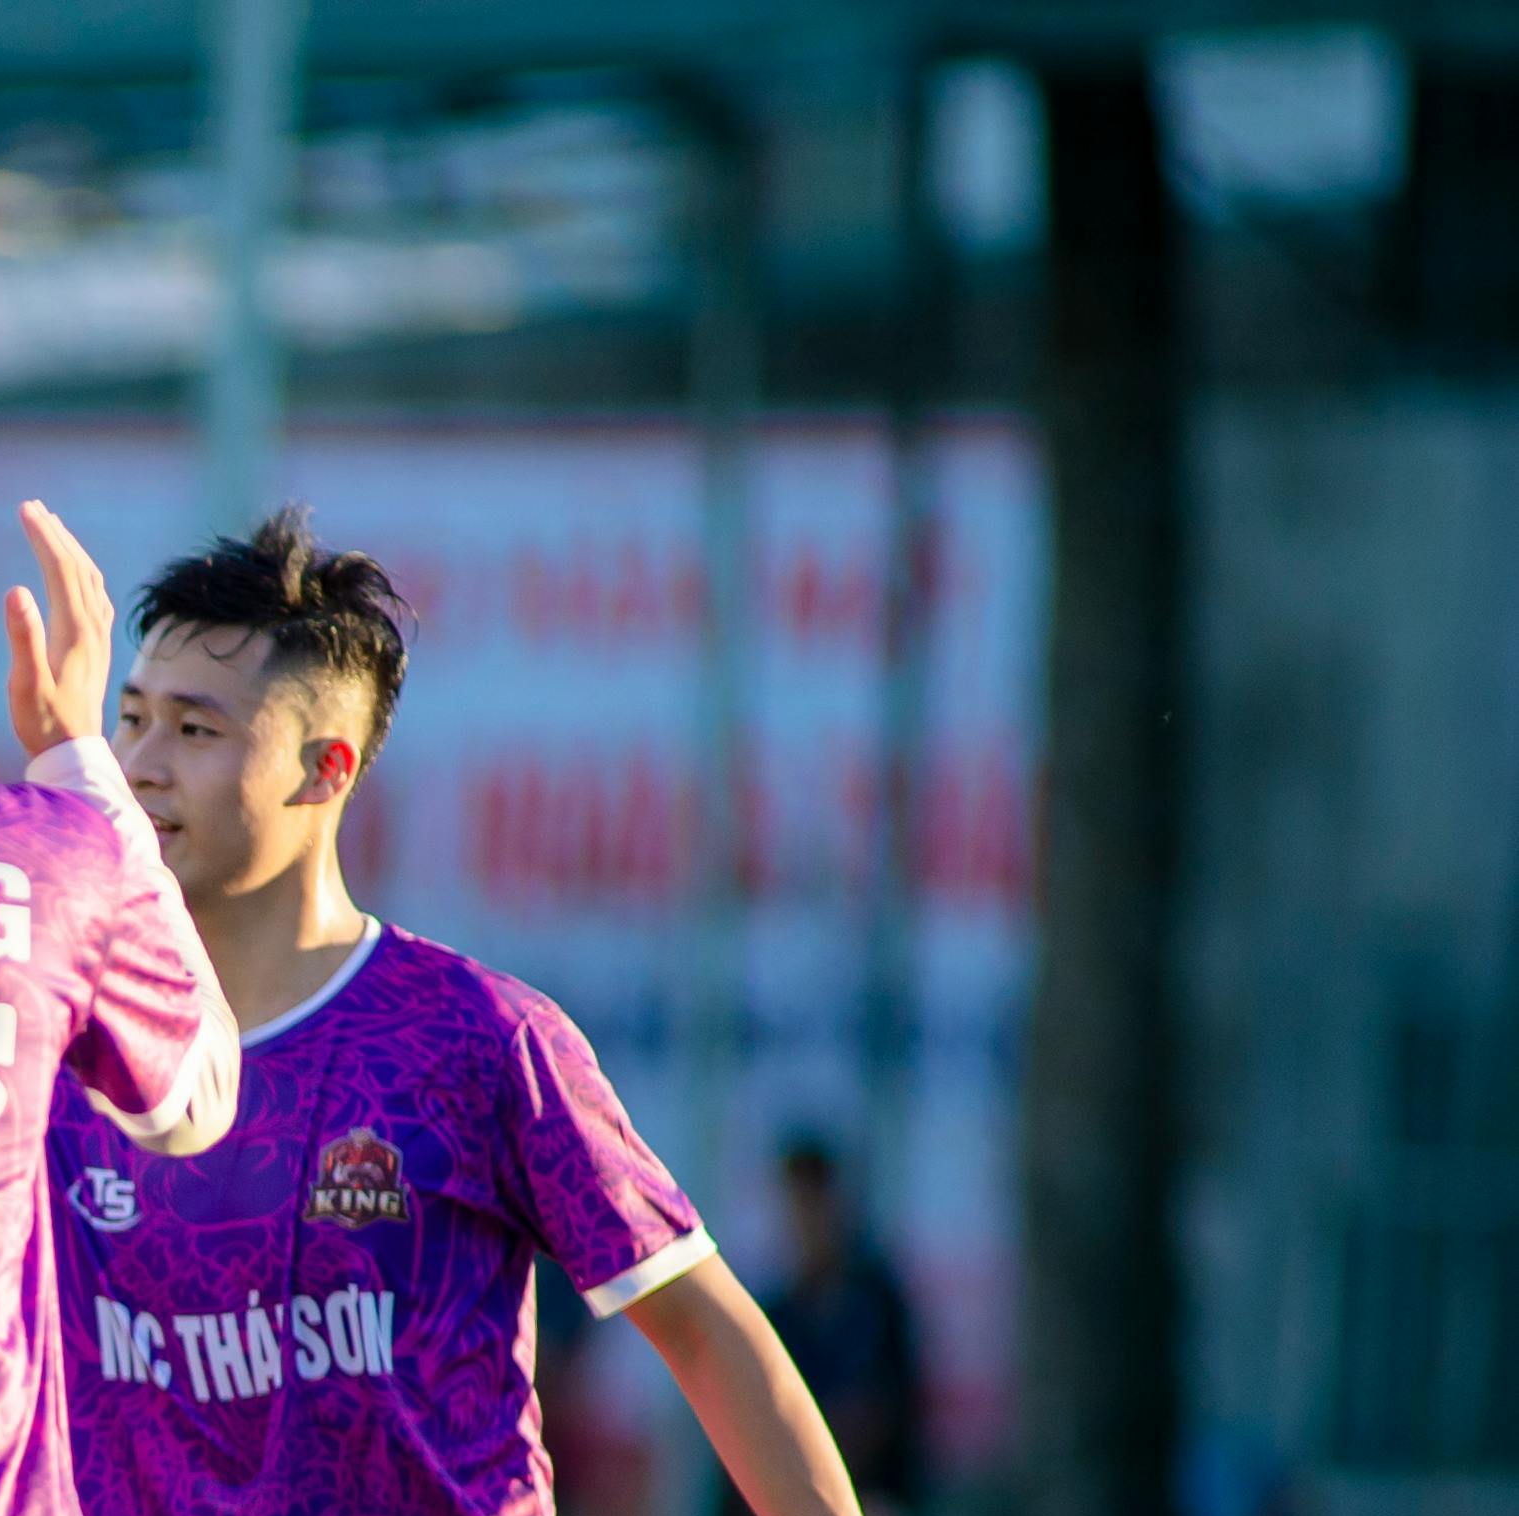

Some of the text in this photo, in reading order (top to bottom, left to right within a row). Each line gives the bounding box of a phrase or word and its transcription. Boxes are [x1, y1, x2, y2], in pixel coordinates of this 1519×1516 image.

[83, 1166, 137, 1221] TS
[313, 1186, 404, 1216] KING
[94, 1282, 396, 1404] MC THÁ SƠN
